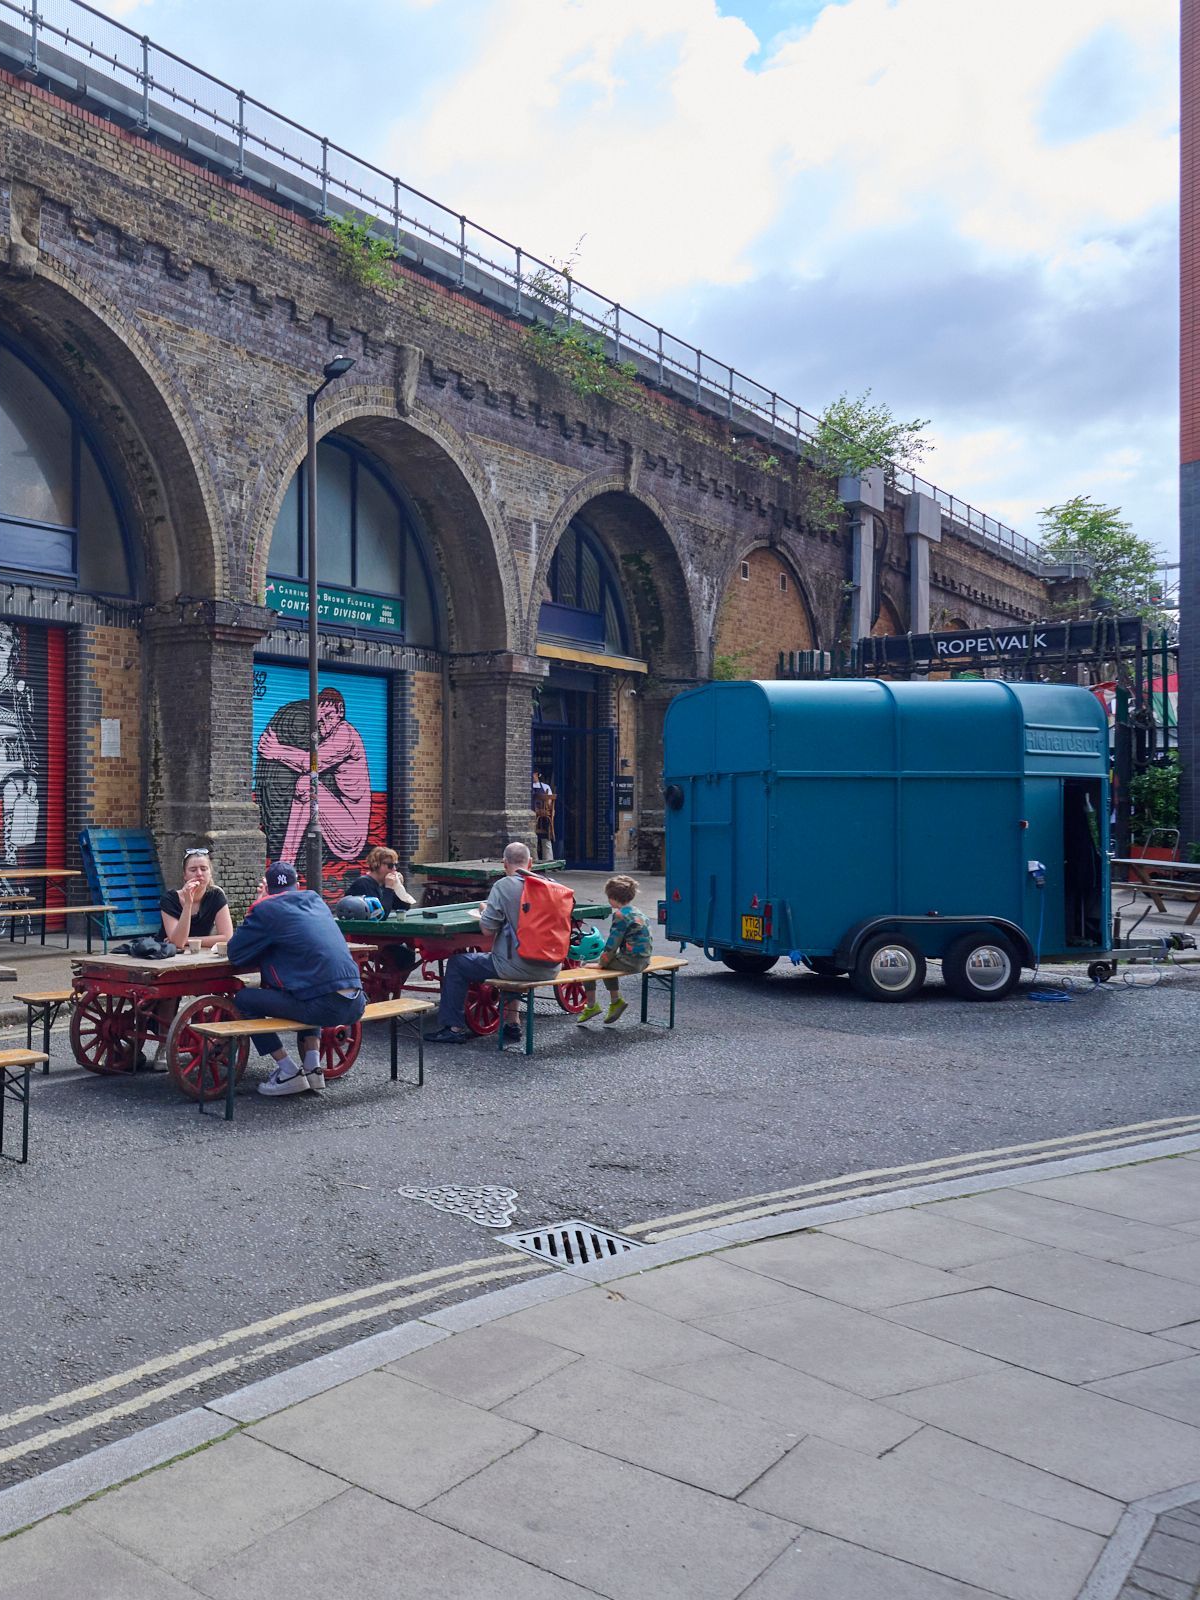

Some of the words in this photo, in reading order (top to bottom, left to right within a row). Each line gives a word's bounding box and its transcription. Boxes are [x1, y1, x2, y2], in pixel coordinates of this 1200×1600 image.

[280, 598, 329, 615] CONTRCT
[333, 607, 372, 621] DIVISION
[937, 633, 1047, 655] ROPEWALK
